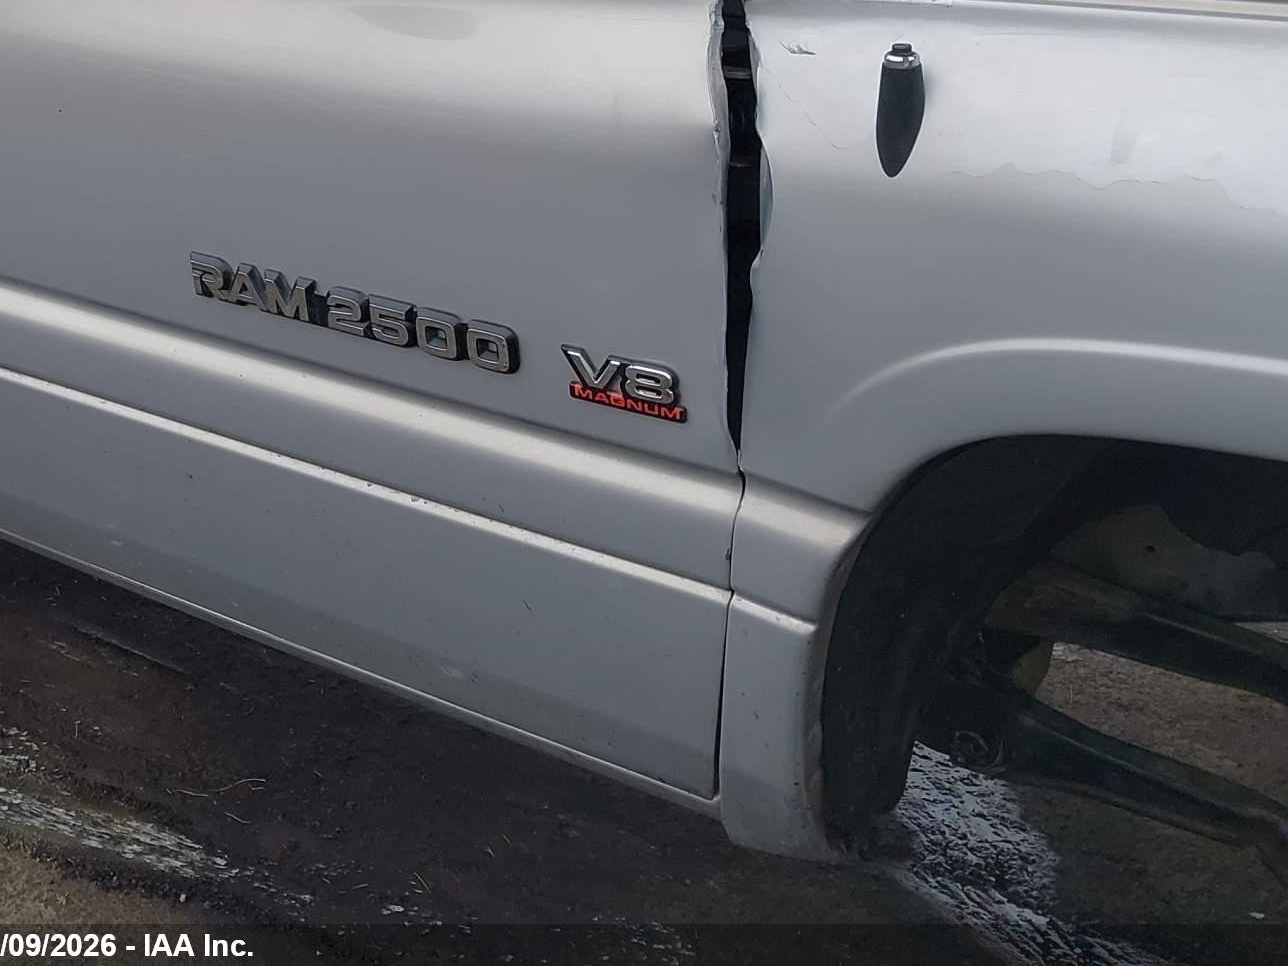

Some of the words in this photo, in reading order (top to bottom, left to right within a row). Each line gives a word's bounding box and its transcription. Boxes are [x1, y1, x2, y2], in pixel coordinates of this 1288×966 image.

[190, 250, 316, 322] RAM
[326, 285, 520, 374] 2500
[561, 344, 680, 405] V8
[573, 383, 682, 420] MAGNUM
